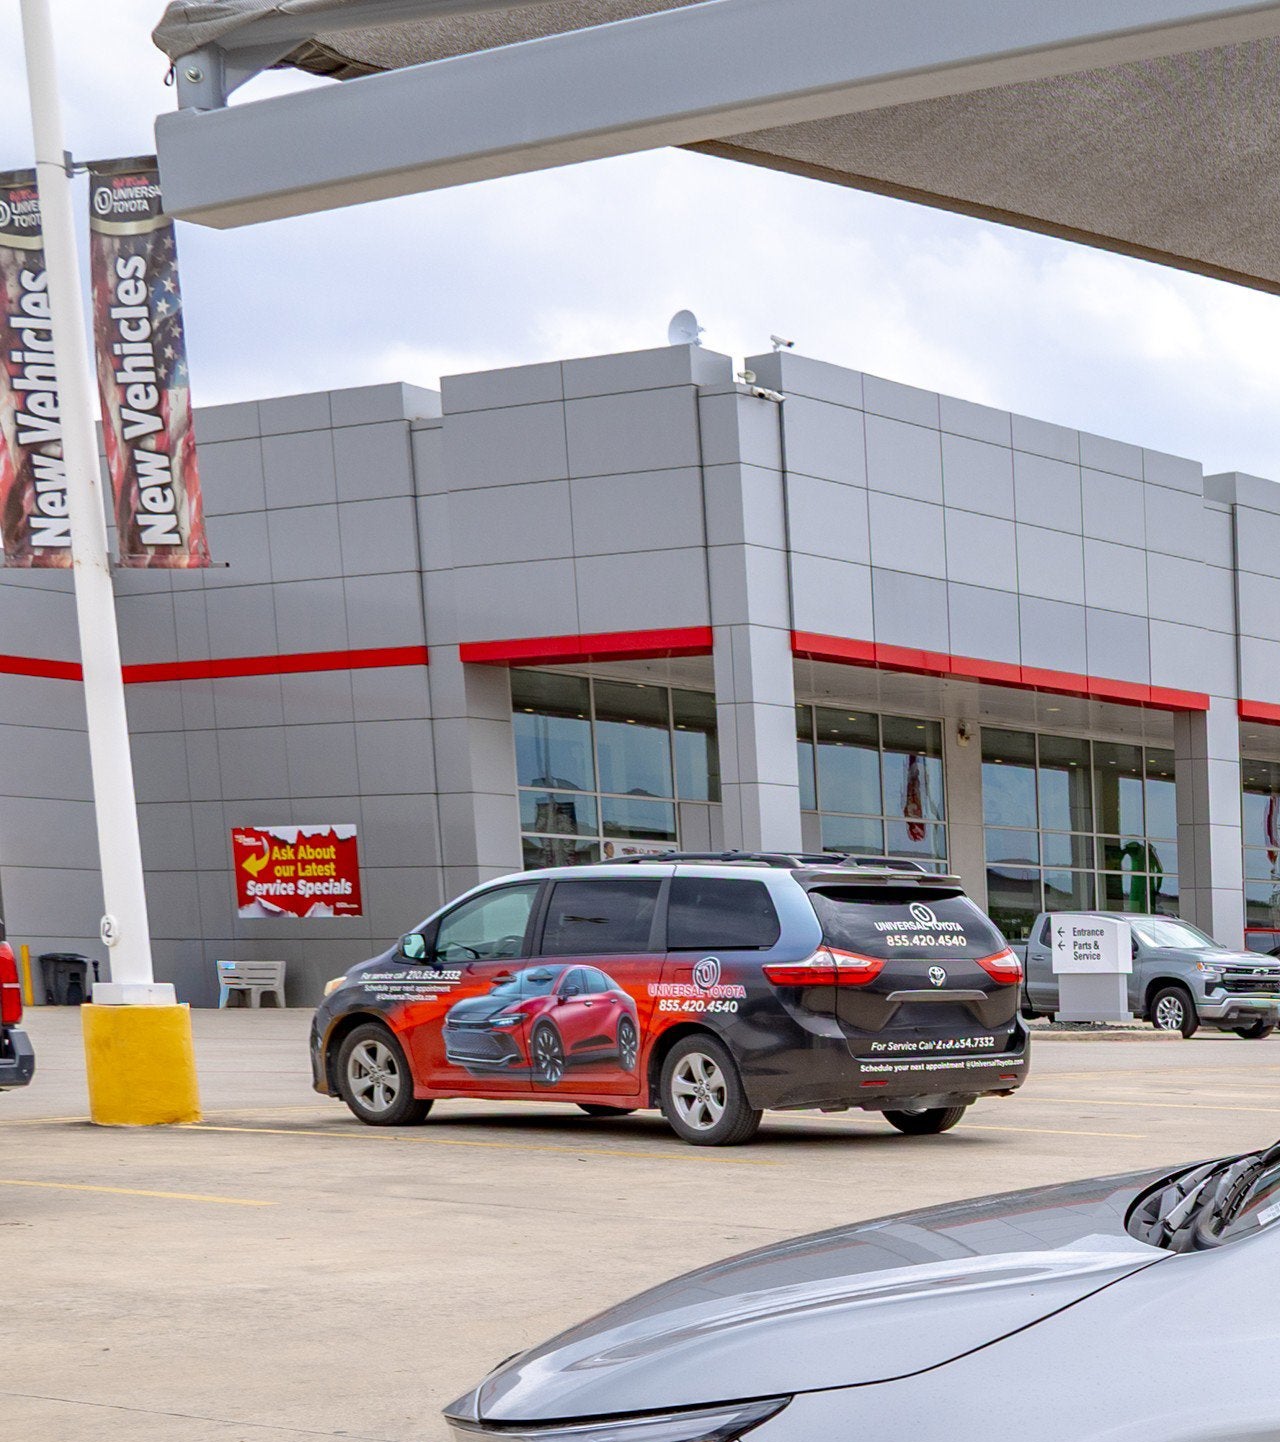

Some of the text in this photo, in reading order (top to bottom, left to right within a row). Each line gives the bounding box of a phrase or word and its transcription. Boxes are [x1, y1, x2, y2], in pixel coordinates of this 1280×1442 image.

[113, 185, 161, 199] UNIVERSA
[113, 199, 149, 213] TOYOTA
[111, 255, 182, 546] New Vehicles
[10, 269, 72, 547] New Vehicles
[271, 845, 336, 861] Ask About
[274, 862, 336, 877] our Latest
[246, 878, 352, 898] Service Specials
[874, 921, 964, 932] UNIVERSAL TOYOTA
[1072, 927, 1105, 938] Entrance
[886, 935, 967, 947] 855.420.4540
[1073, 940, 1100, 951] Parts &
[1073, 951, 1101, 961] Service
[648, 983, 747, 998] UNIVERSAL TOYOTA
[659, 1000, 738, 1013] 855.420.4540
[871, 1042, 886, 1051] For
[887, 1041, 917, 1051] Service
[860, 1064, 893, 1073] Schedule
[893, 1064, 909, 1073] your
[910, 1063, 925, 1071] next
[926, 1061, 965, 1072] appointment
